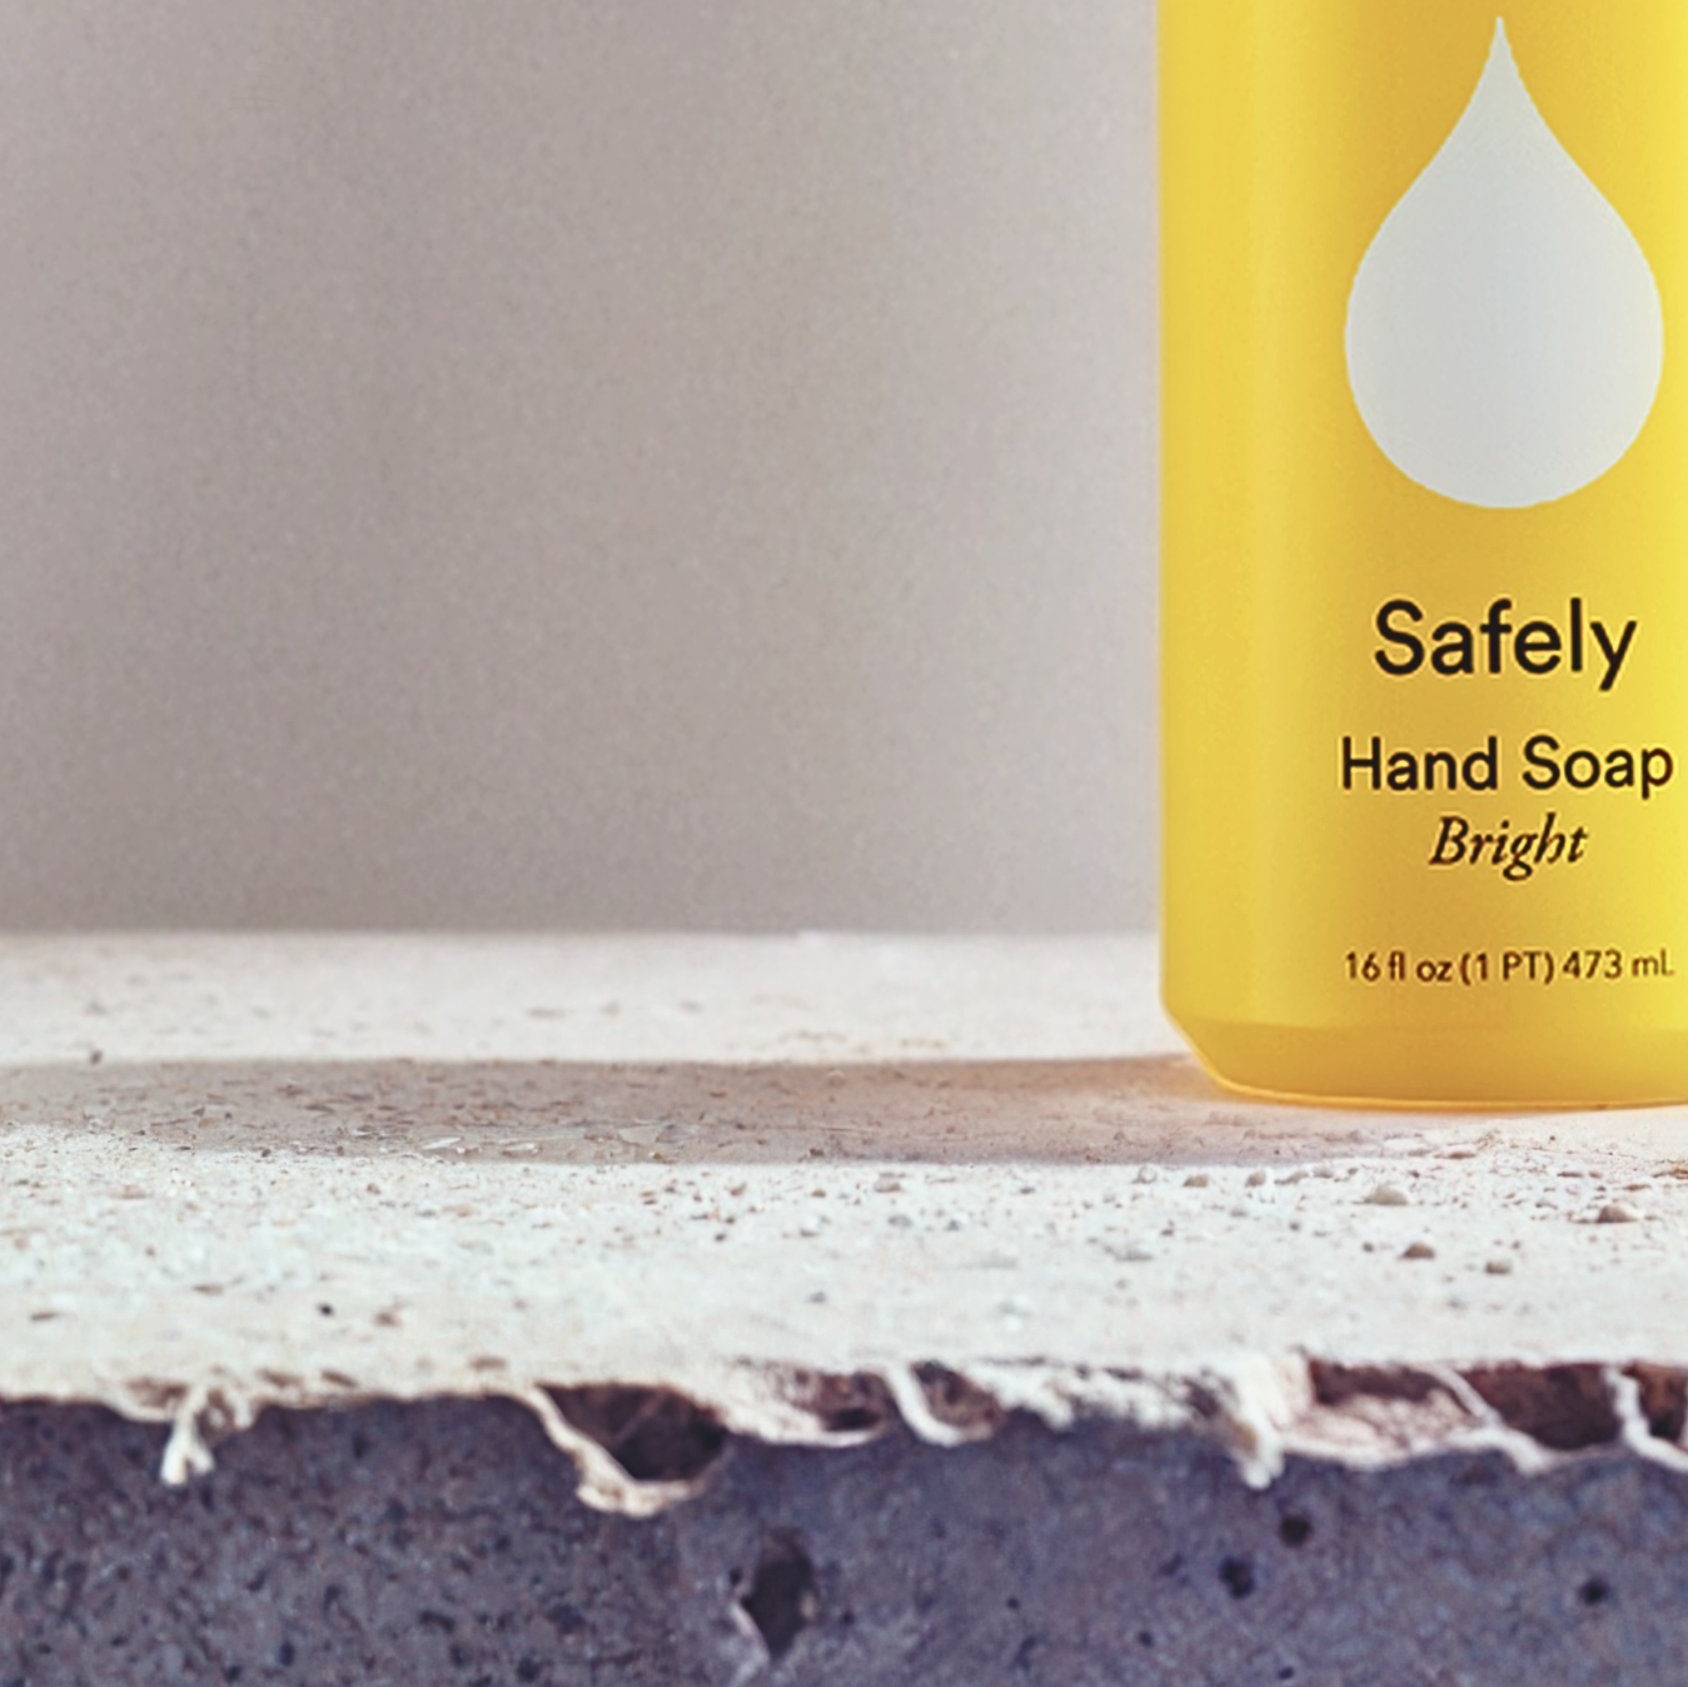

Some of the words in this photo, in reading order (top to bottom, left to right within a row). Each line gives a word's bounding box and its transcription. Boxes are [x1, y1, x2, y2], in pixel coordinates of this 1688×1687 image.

[1374, 597, 1638, 692] Safely
[1342, 735, 1499, 792] Hand
[1522, 734, 1674, 800] Soap
[1428, 812, 1589, 882] Bright
[1346, 951, 1381, 982] 16
[1388, 950, 1406, 981] fl
[1415, 960, 1454, 983] oz
[1459, 952, 1489, 986] (1
[1502, 950, 1555, 985] PT)
[1562, 948, 1622, 980] 473
